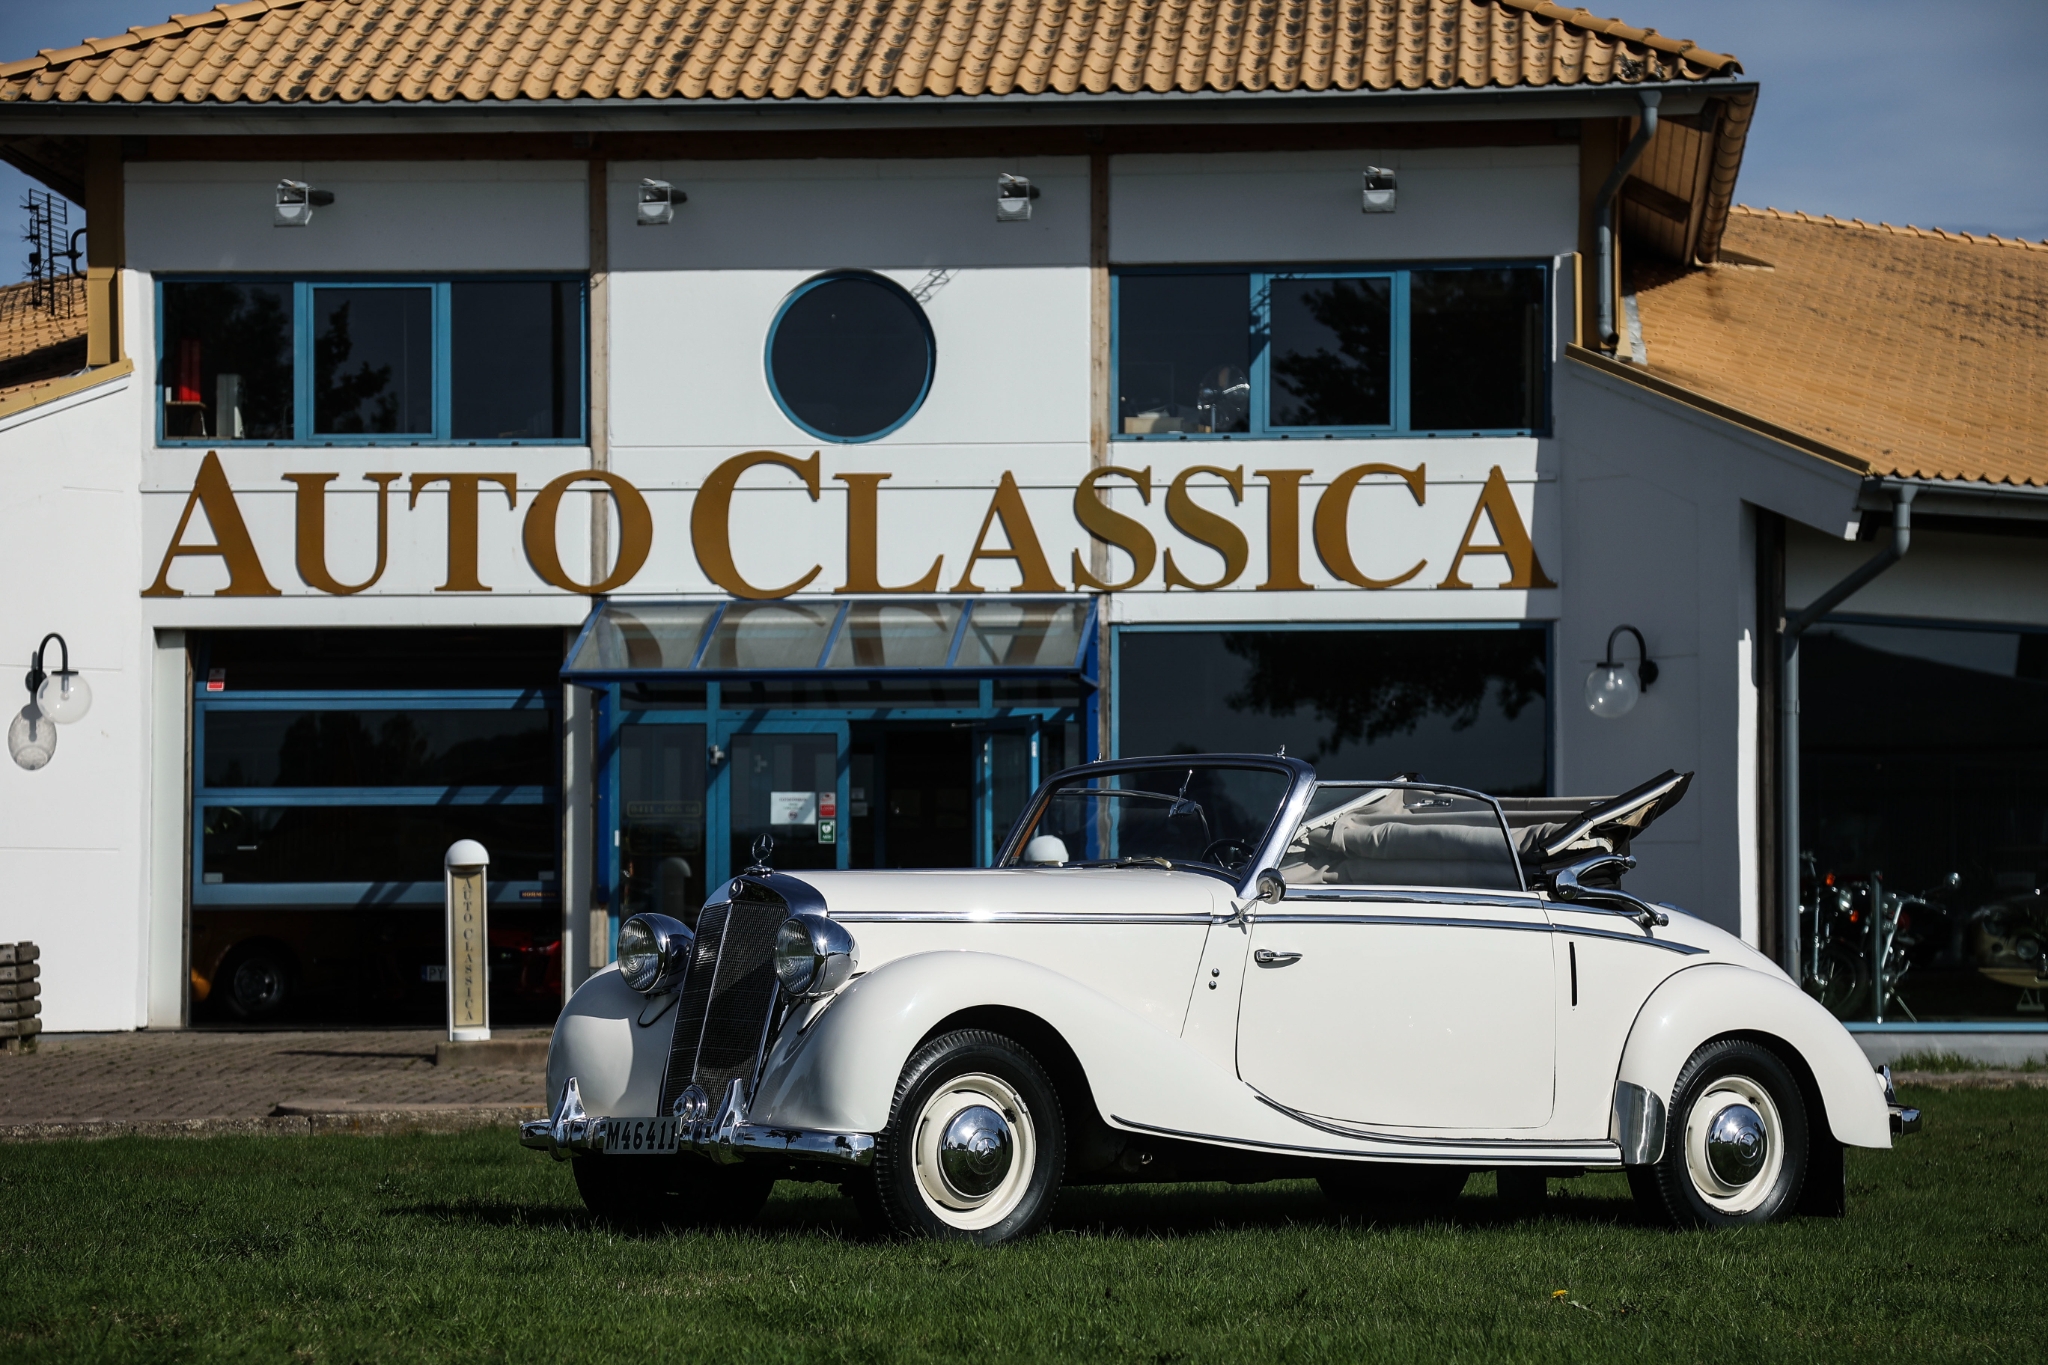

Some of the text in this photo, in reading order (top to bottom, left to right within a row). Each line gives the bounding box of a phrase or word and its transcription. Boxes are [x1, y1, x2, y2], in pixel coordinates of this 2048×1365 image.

[140, 450, 1558, 600] AUTO CLASSICA
[463, 877, 474, 1021] AUTO CLASSICA
[606, 1121, 677, 1150] M46411
